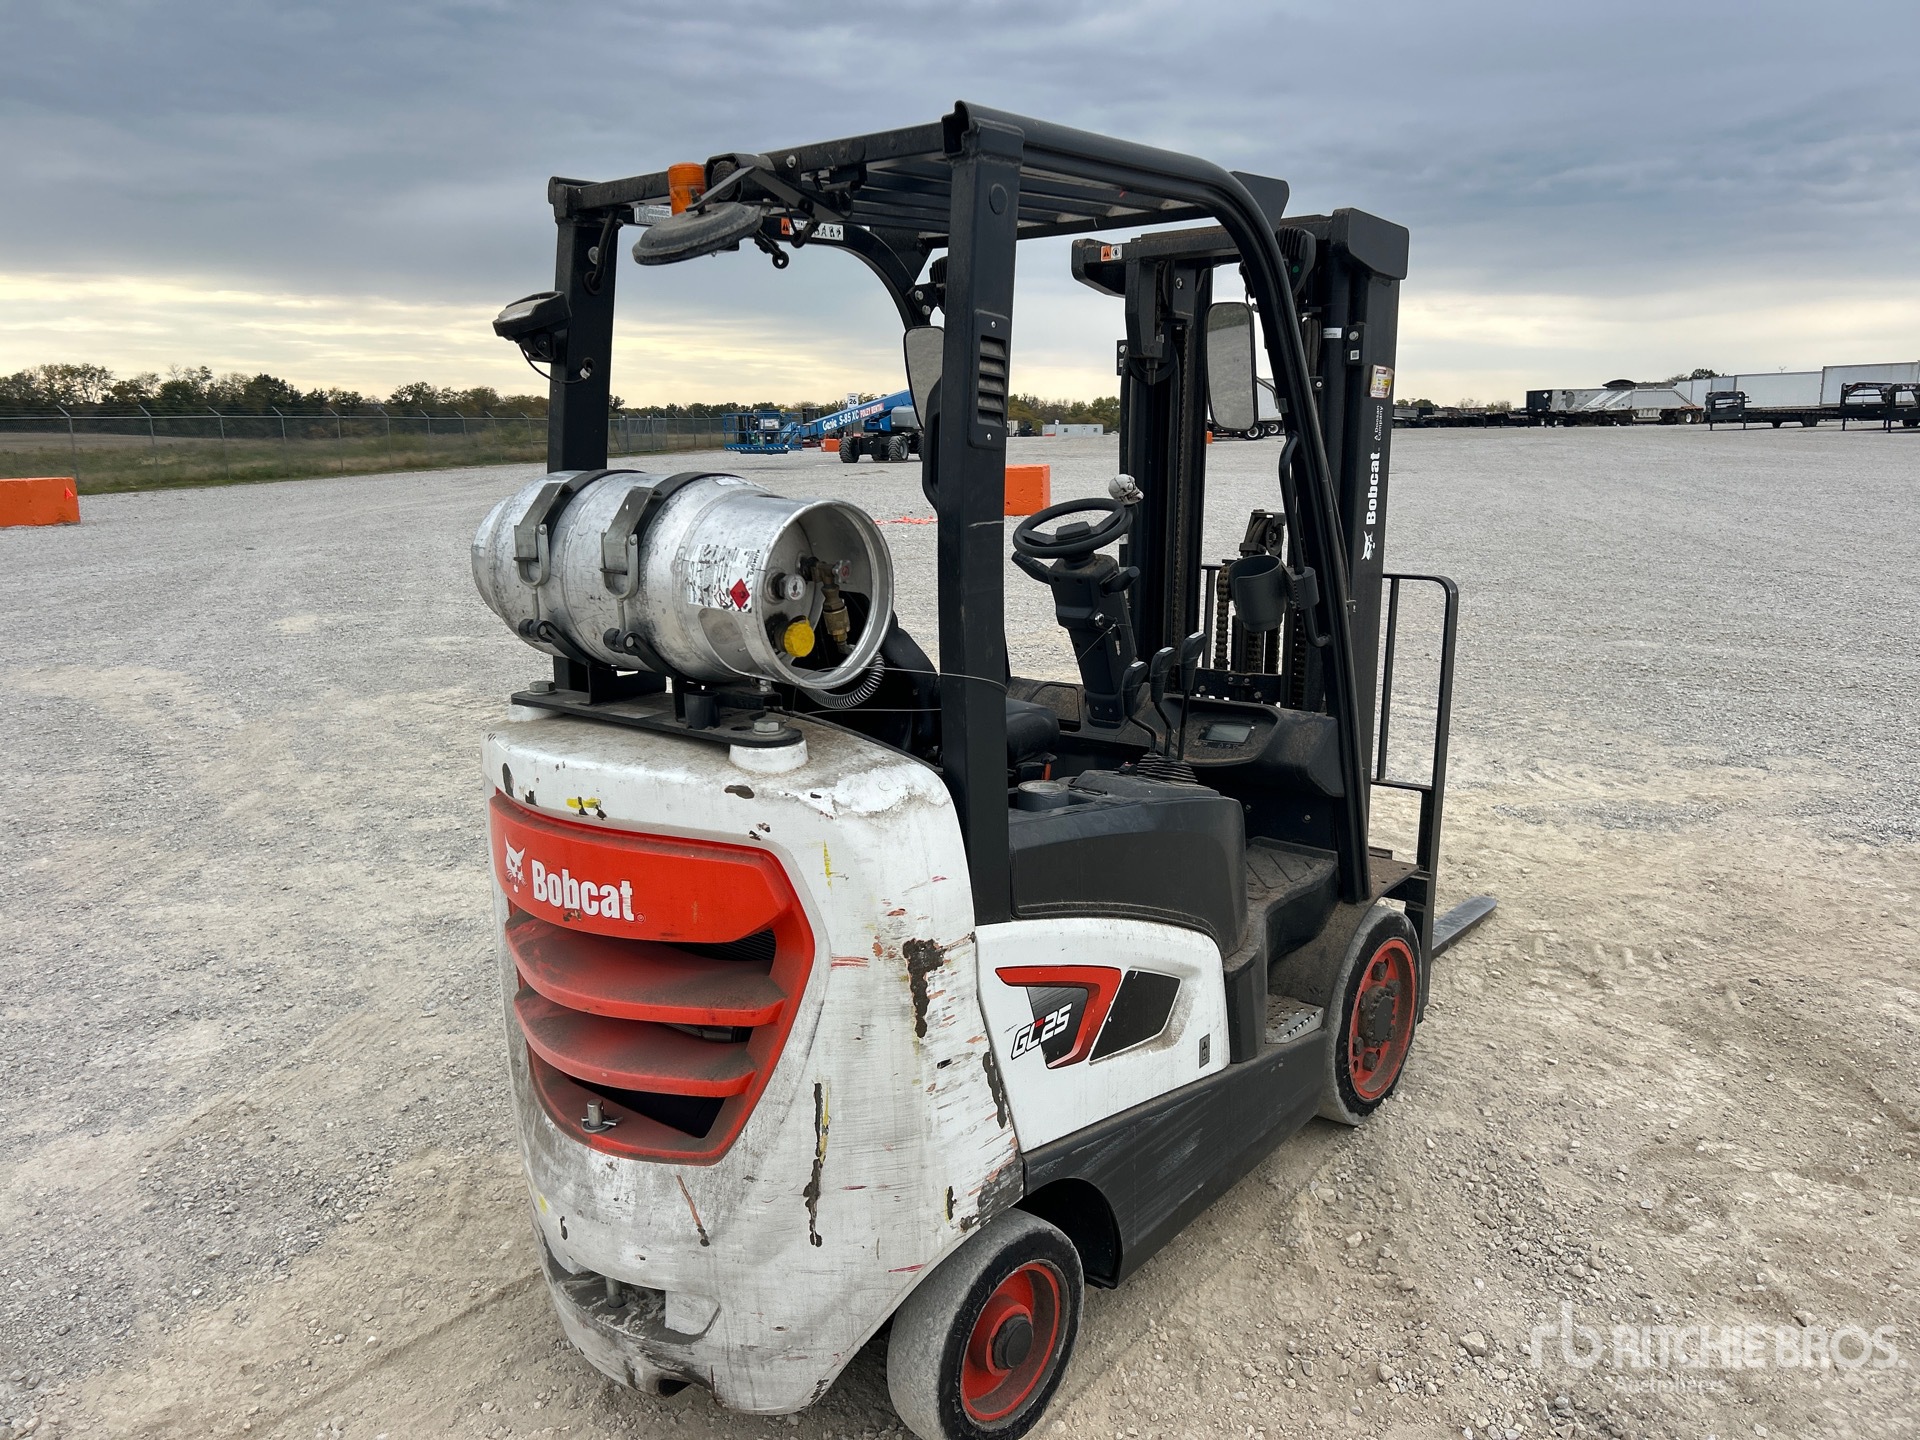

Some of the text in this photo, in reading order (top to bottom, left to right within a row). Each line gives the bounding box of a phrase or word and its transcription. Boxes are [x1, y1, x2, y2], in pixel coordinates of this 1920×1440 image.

[822, 409, 859, 431] Genie S-85 XC
[1365, 452, 1380, 525] Bobcat
[531, 859, 635, 922] Bobcat
[1010, 1002, 1073, 1061] GL25
